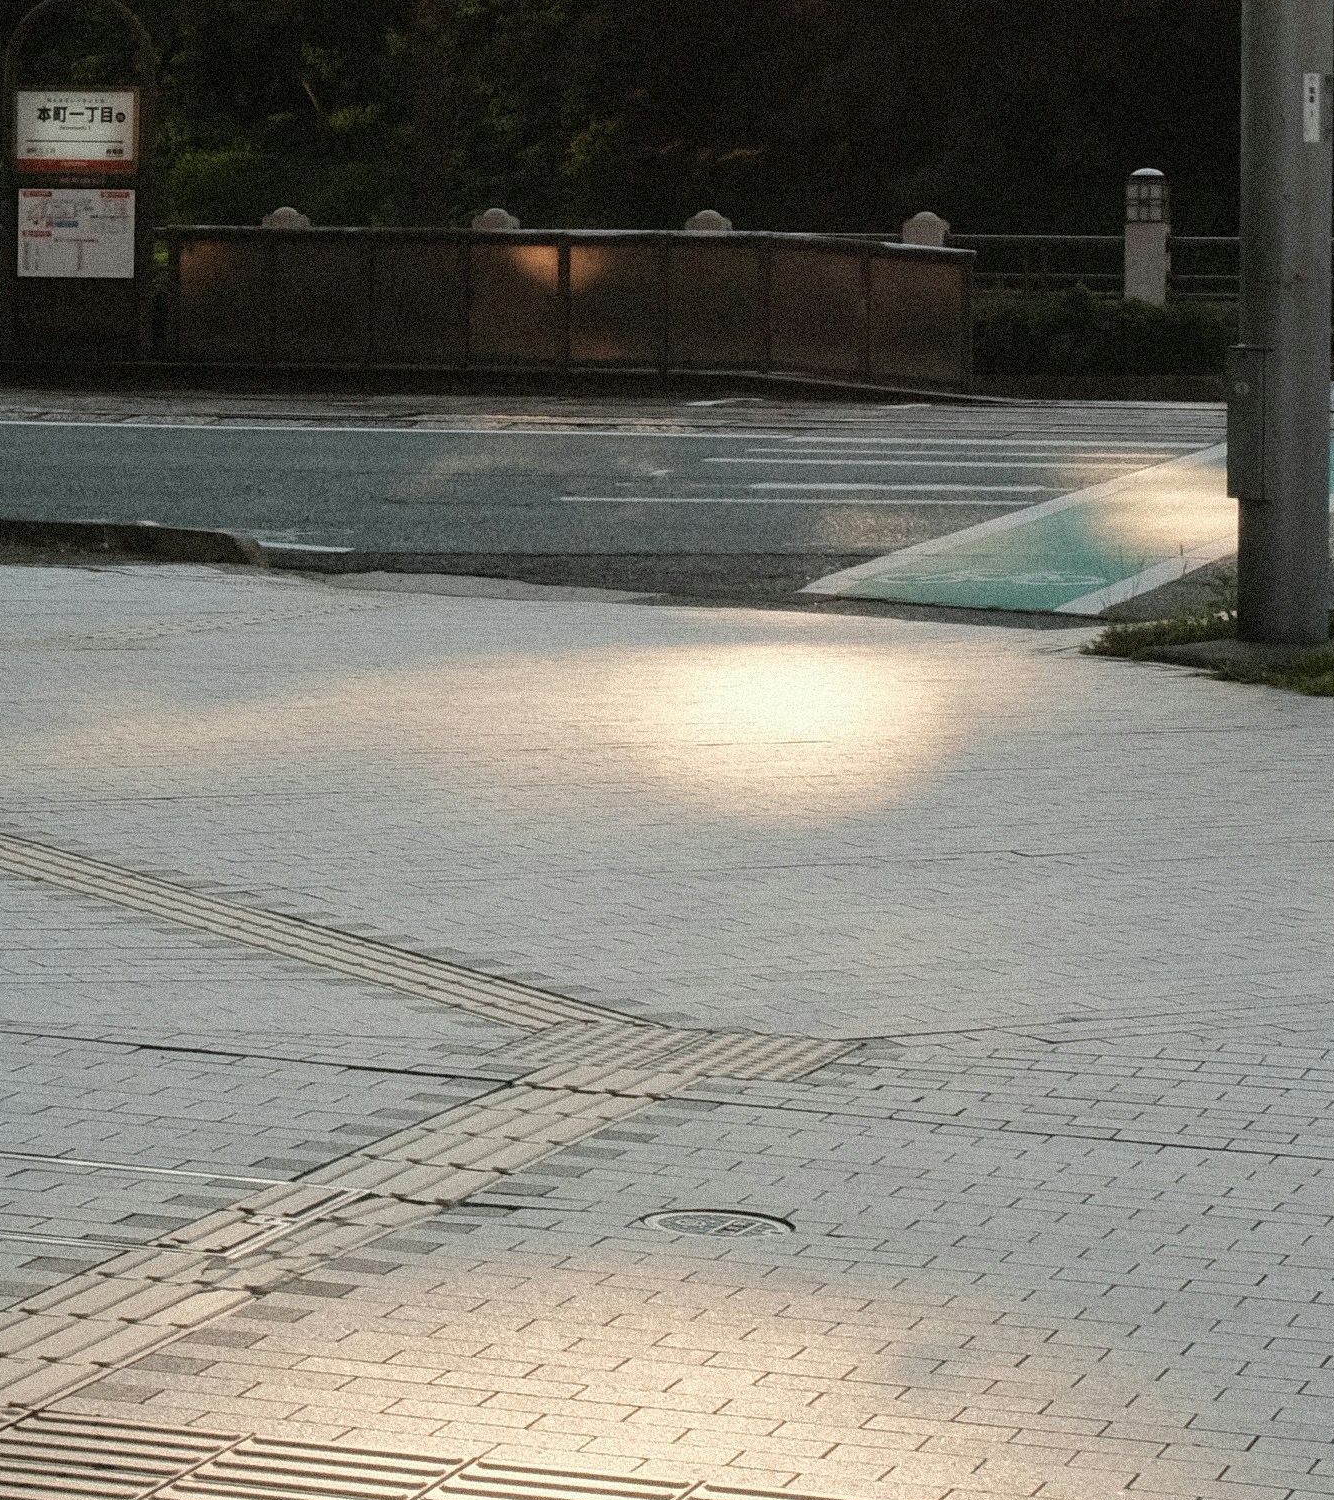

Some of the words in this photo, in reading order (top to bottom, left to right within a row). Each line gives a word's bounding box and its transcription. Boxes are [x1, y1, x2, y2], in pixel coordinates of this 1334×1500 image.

[36, 106, 114, 123] 本町一丁目
